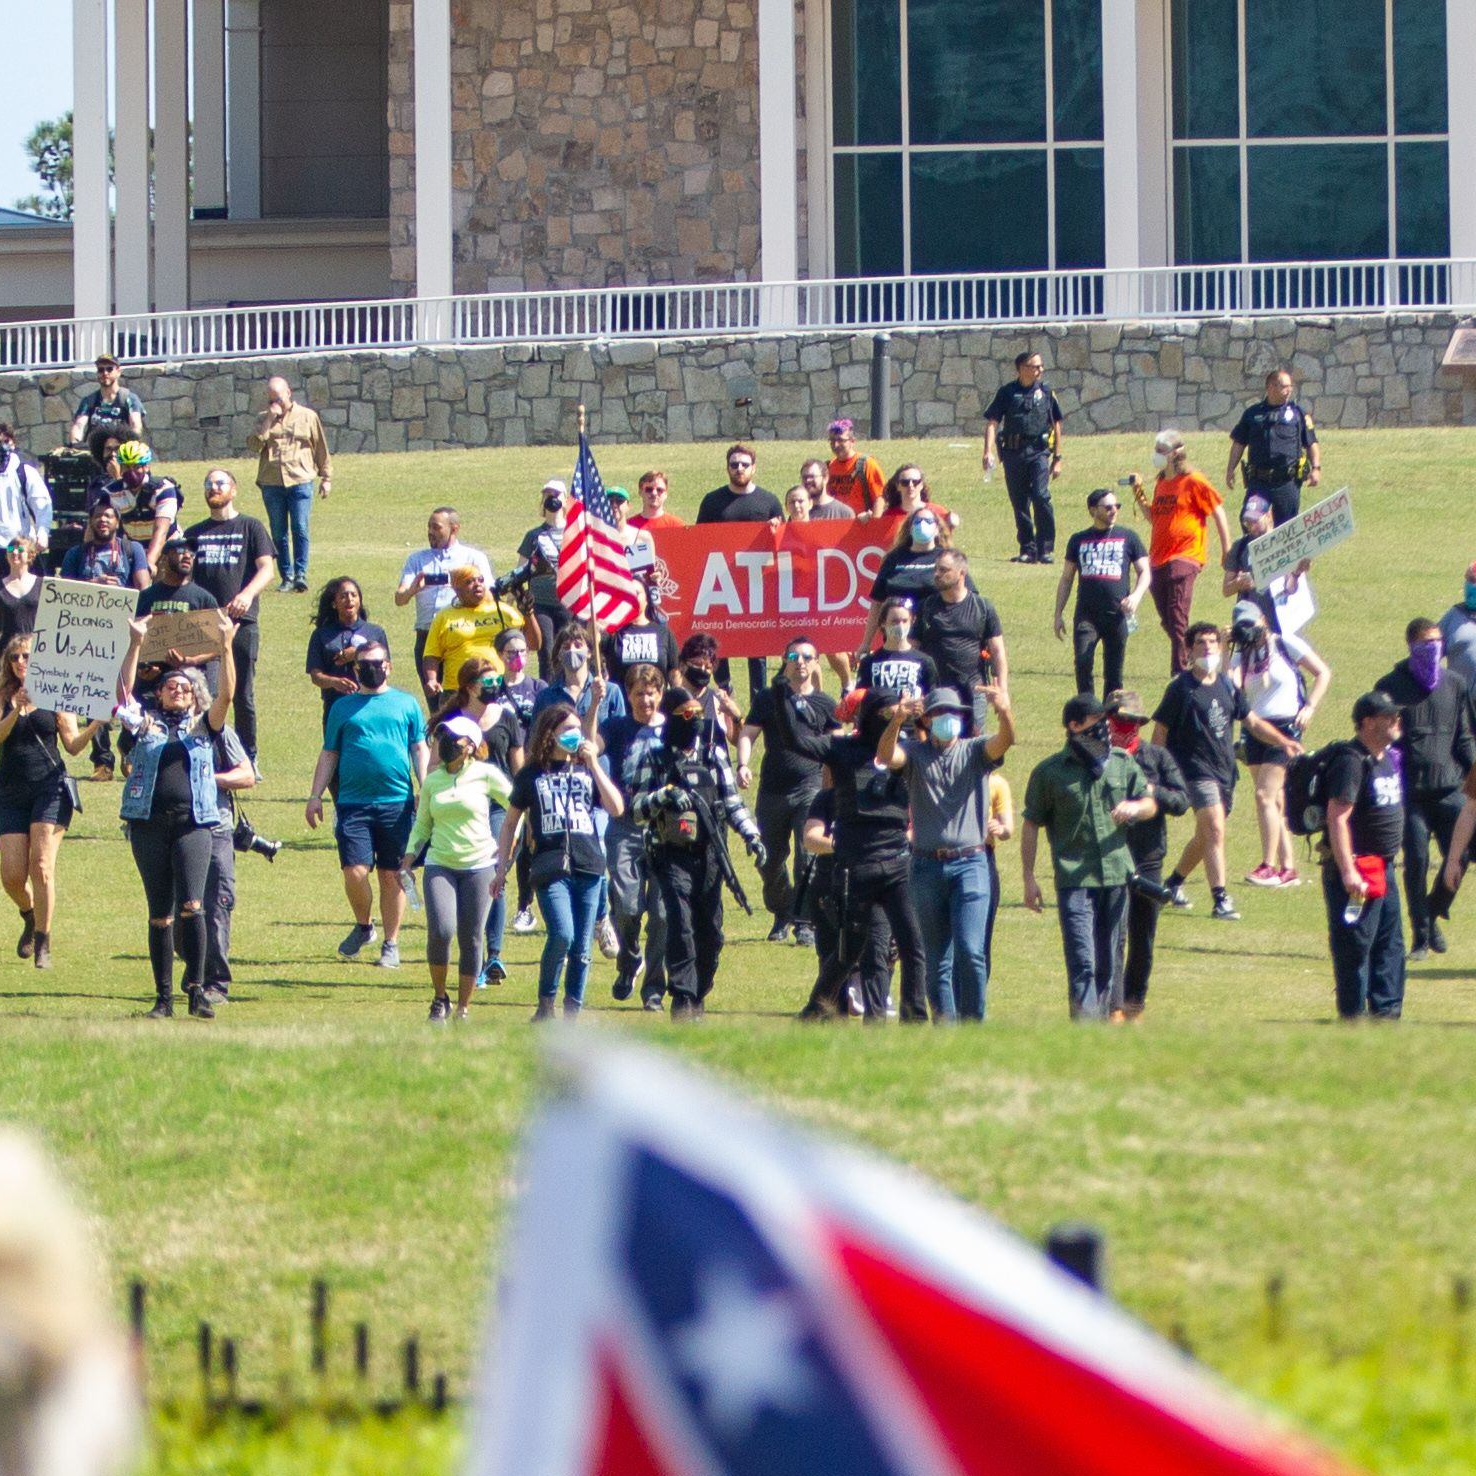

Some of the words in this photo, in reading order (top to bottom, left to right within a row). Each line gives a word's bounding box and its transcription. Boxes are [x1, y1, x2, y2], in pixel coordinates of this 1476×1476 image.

[45, 582, 95, 609] SACRED
[57, 609, 114, 630] BELONGS
[691, 619, 724, 631] Atlanta
[725, 618, 777, 630] Democratic
[778, 616, 819, 628] Socialists
[821, 615, 832, 626] of
[29, 661, 70, 681] Symbols
[61, 680, 81, 697] NO
[540, 790, 592, 815] LIVES
